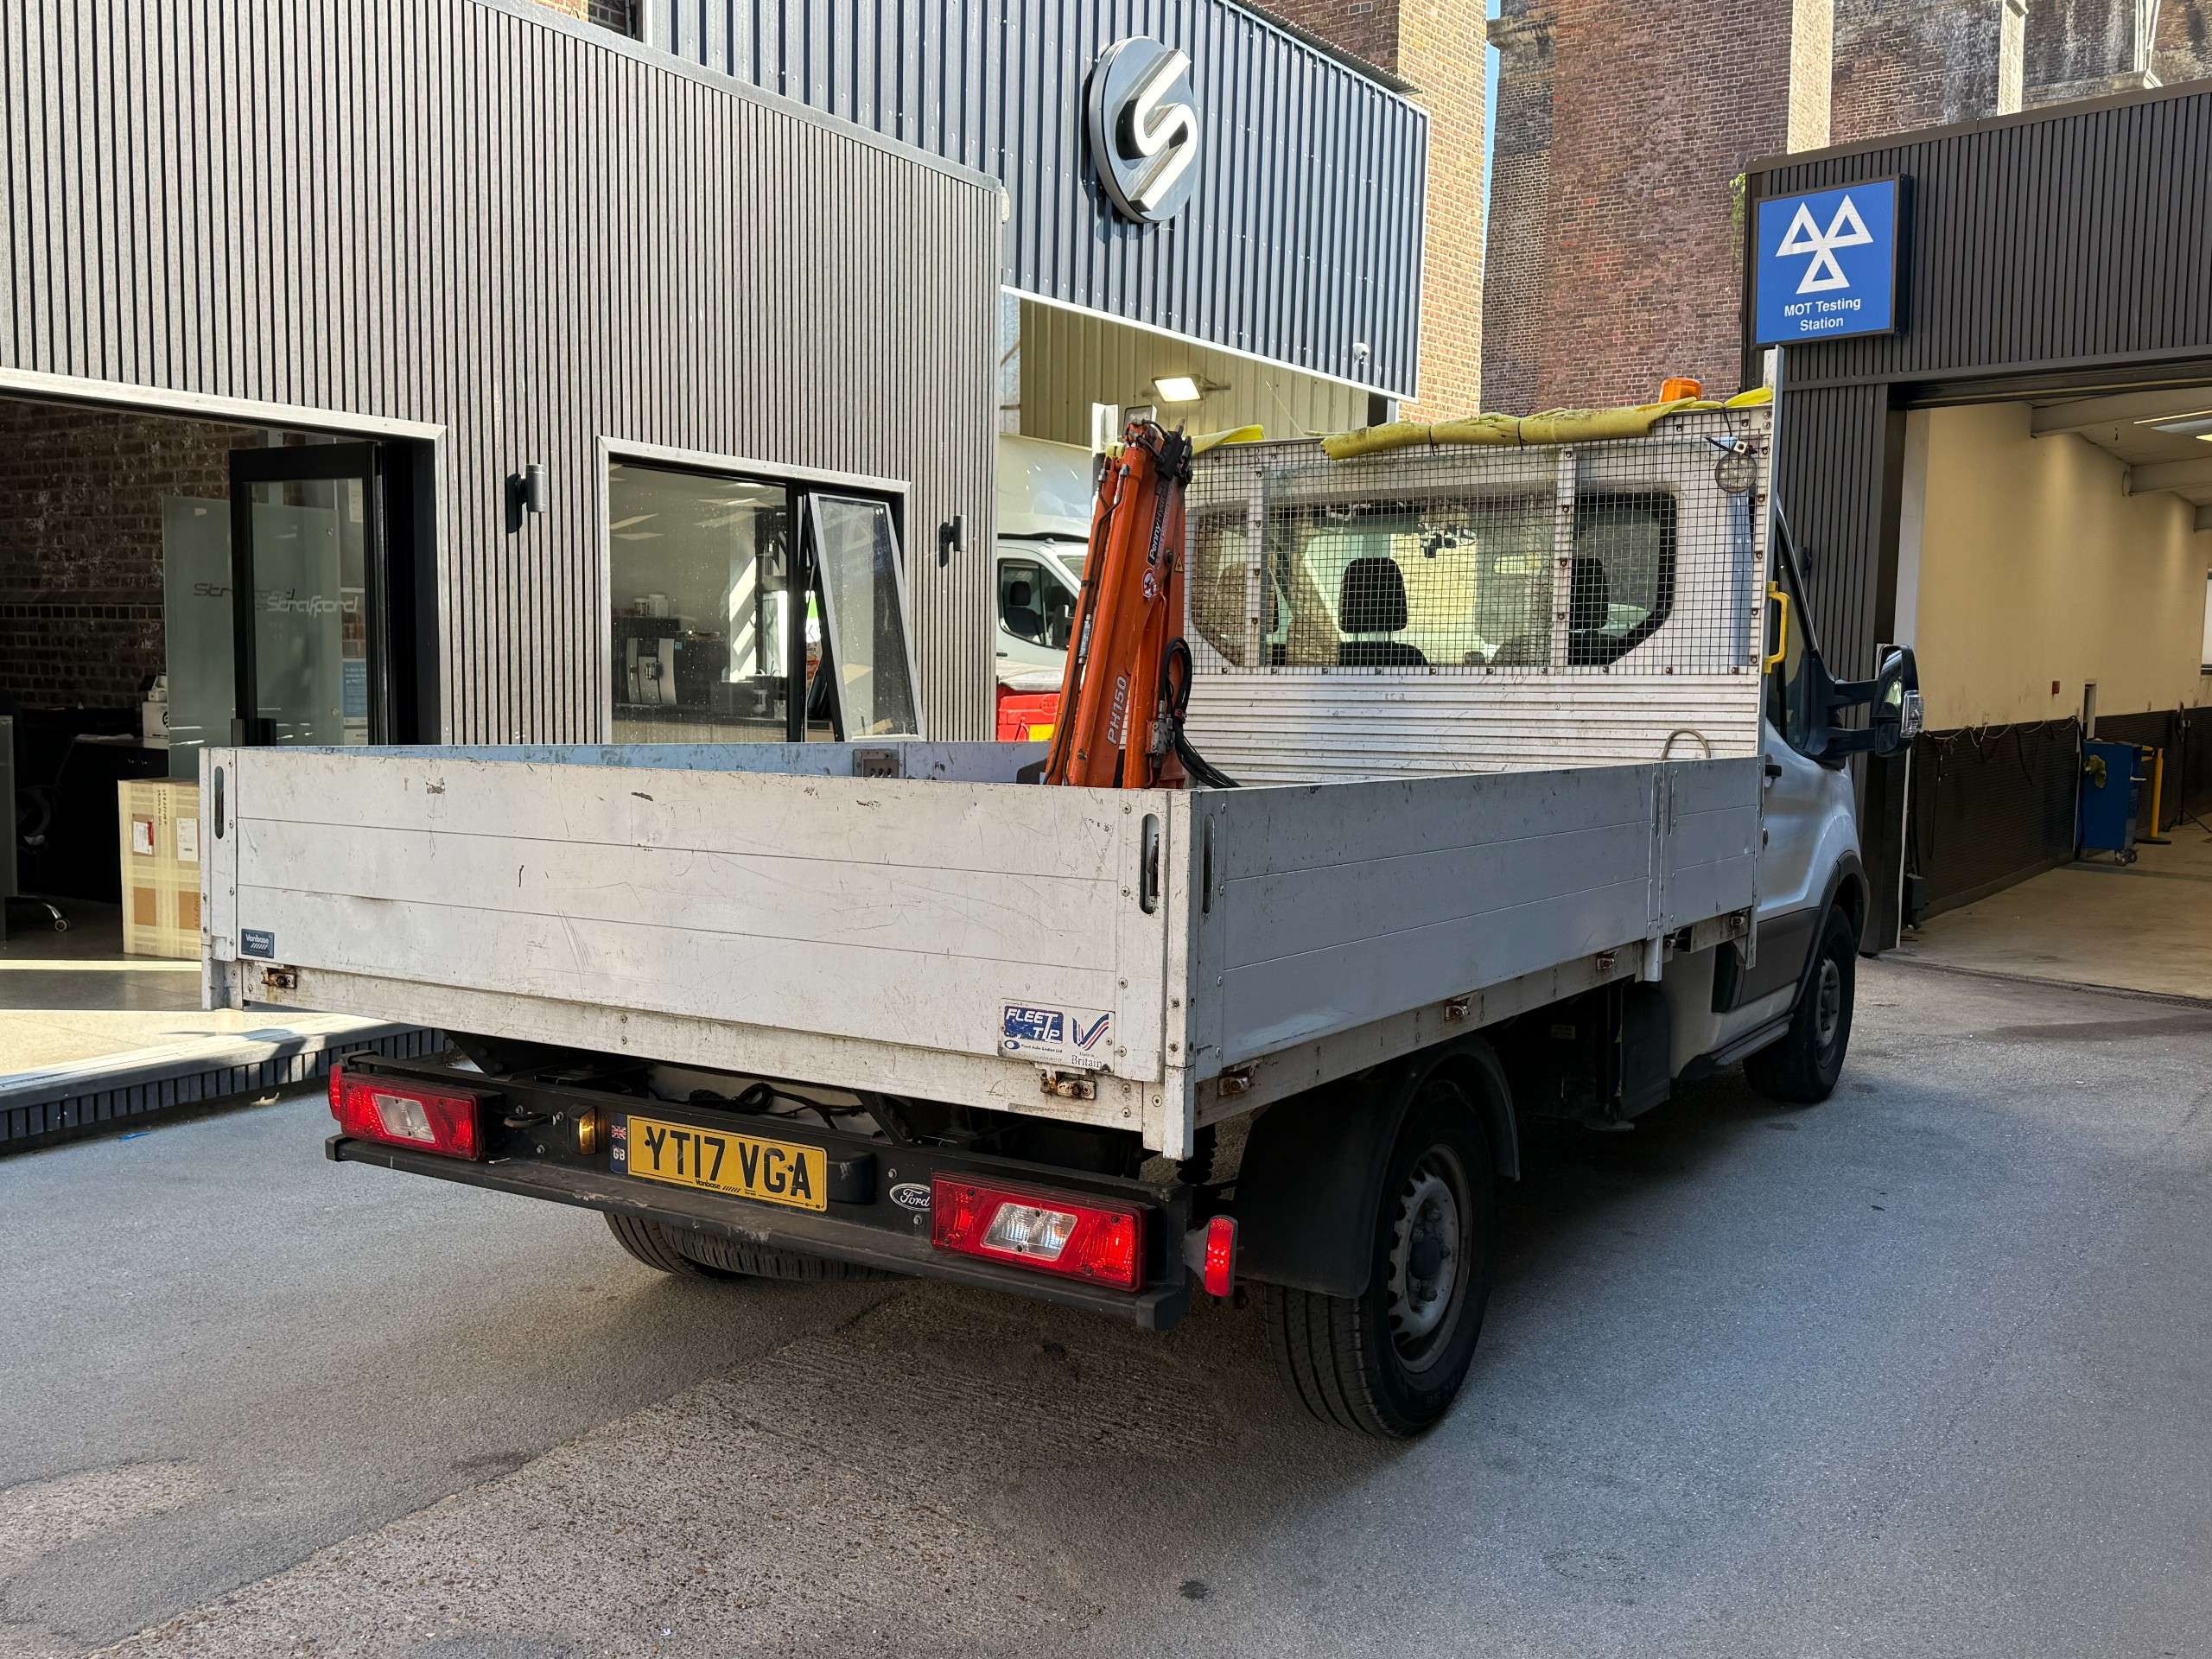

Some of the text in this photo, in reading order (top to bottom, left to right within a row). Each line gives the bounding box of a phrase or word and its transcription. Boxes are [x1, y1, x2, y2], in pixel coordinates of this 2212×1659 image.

[1784, 298, 1861, 317] MOT Testing
[1800, 317, 1844, 331] Station
[1107, 676, 1127, 745] PH150
[245, 933, 270, 944] Vanbase
[1006, 1007, 1058, 1028] FLEET
[1033, 1026, 1060, 1040] TIP
[1071, 1054, 1103, 1068] Britain
[613, 1147, 626, 1161] GB
[645, 1126, 812, 1200] YT17 VGA
[695, 1179, 721, 1190] Vanbase
[899, 1188, 931, 1207] Ford
